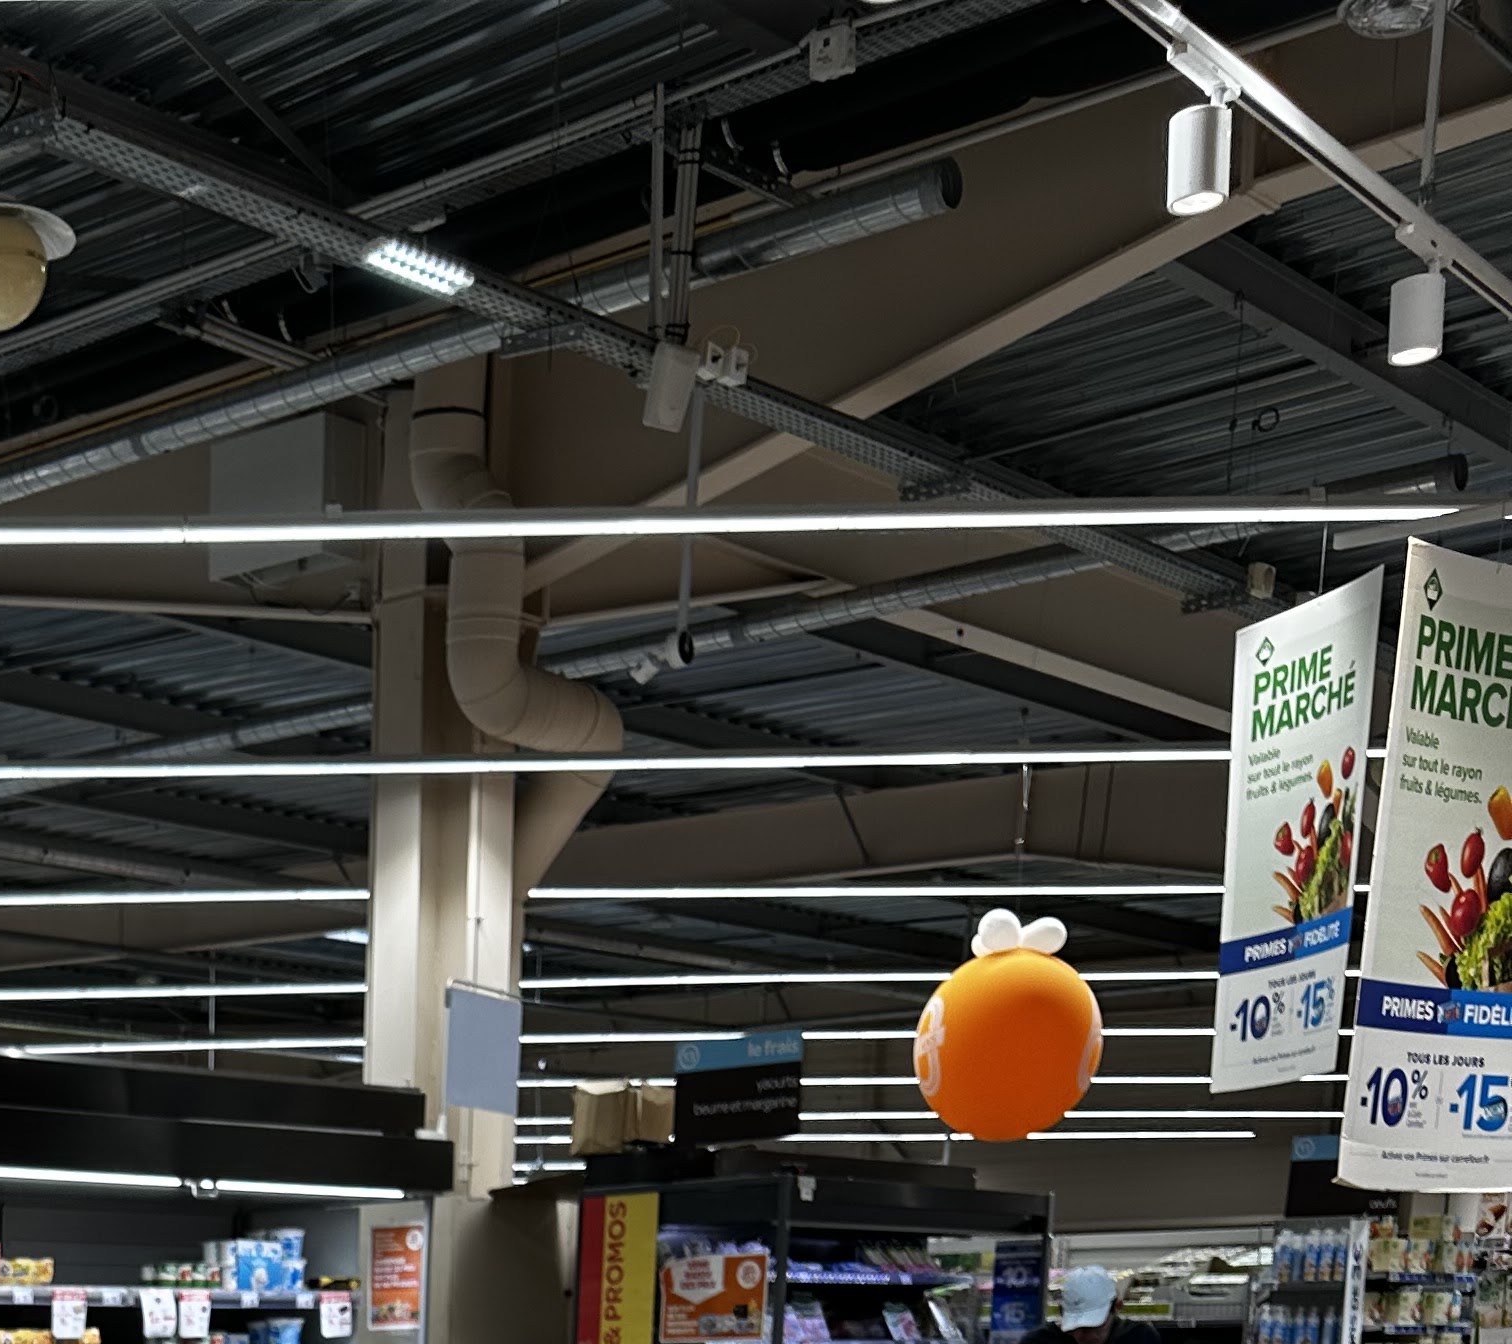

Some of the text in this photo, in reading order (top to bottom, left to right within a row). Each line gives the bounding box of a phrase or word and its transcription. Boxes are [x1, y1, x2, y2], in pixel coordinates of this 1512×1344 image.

[1416, 613, 1512, 680] PRIME
[1253, 644, 1333, 706] PRIME
[1251, 660, 1356, 743] MARCHÉ
[1405, 726, 1440, 750] Valable
[1402, 753, 1482, 783] sur tout le rayon
[1400, 774, 1423, 794] fruits
[1425, 780, 1432, 796] &
[1244, 938, 1287, 963] PRIMES
[1381, 996, 1435, 1021] PRIMES
[747, 1038, 798, 1057] le frais
[1407, 1052, 1485, 1068] TOUS LES JOURS
[604, 1200, 628, 1322] PROMOS
